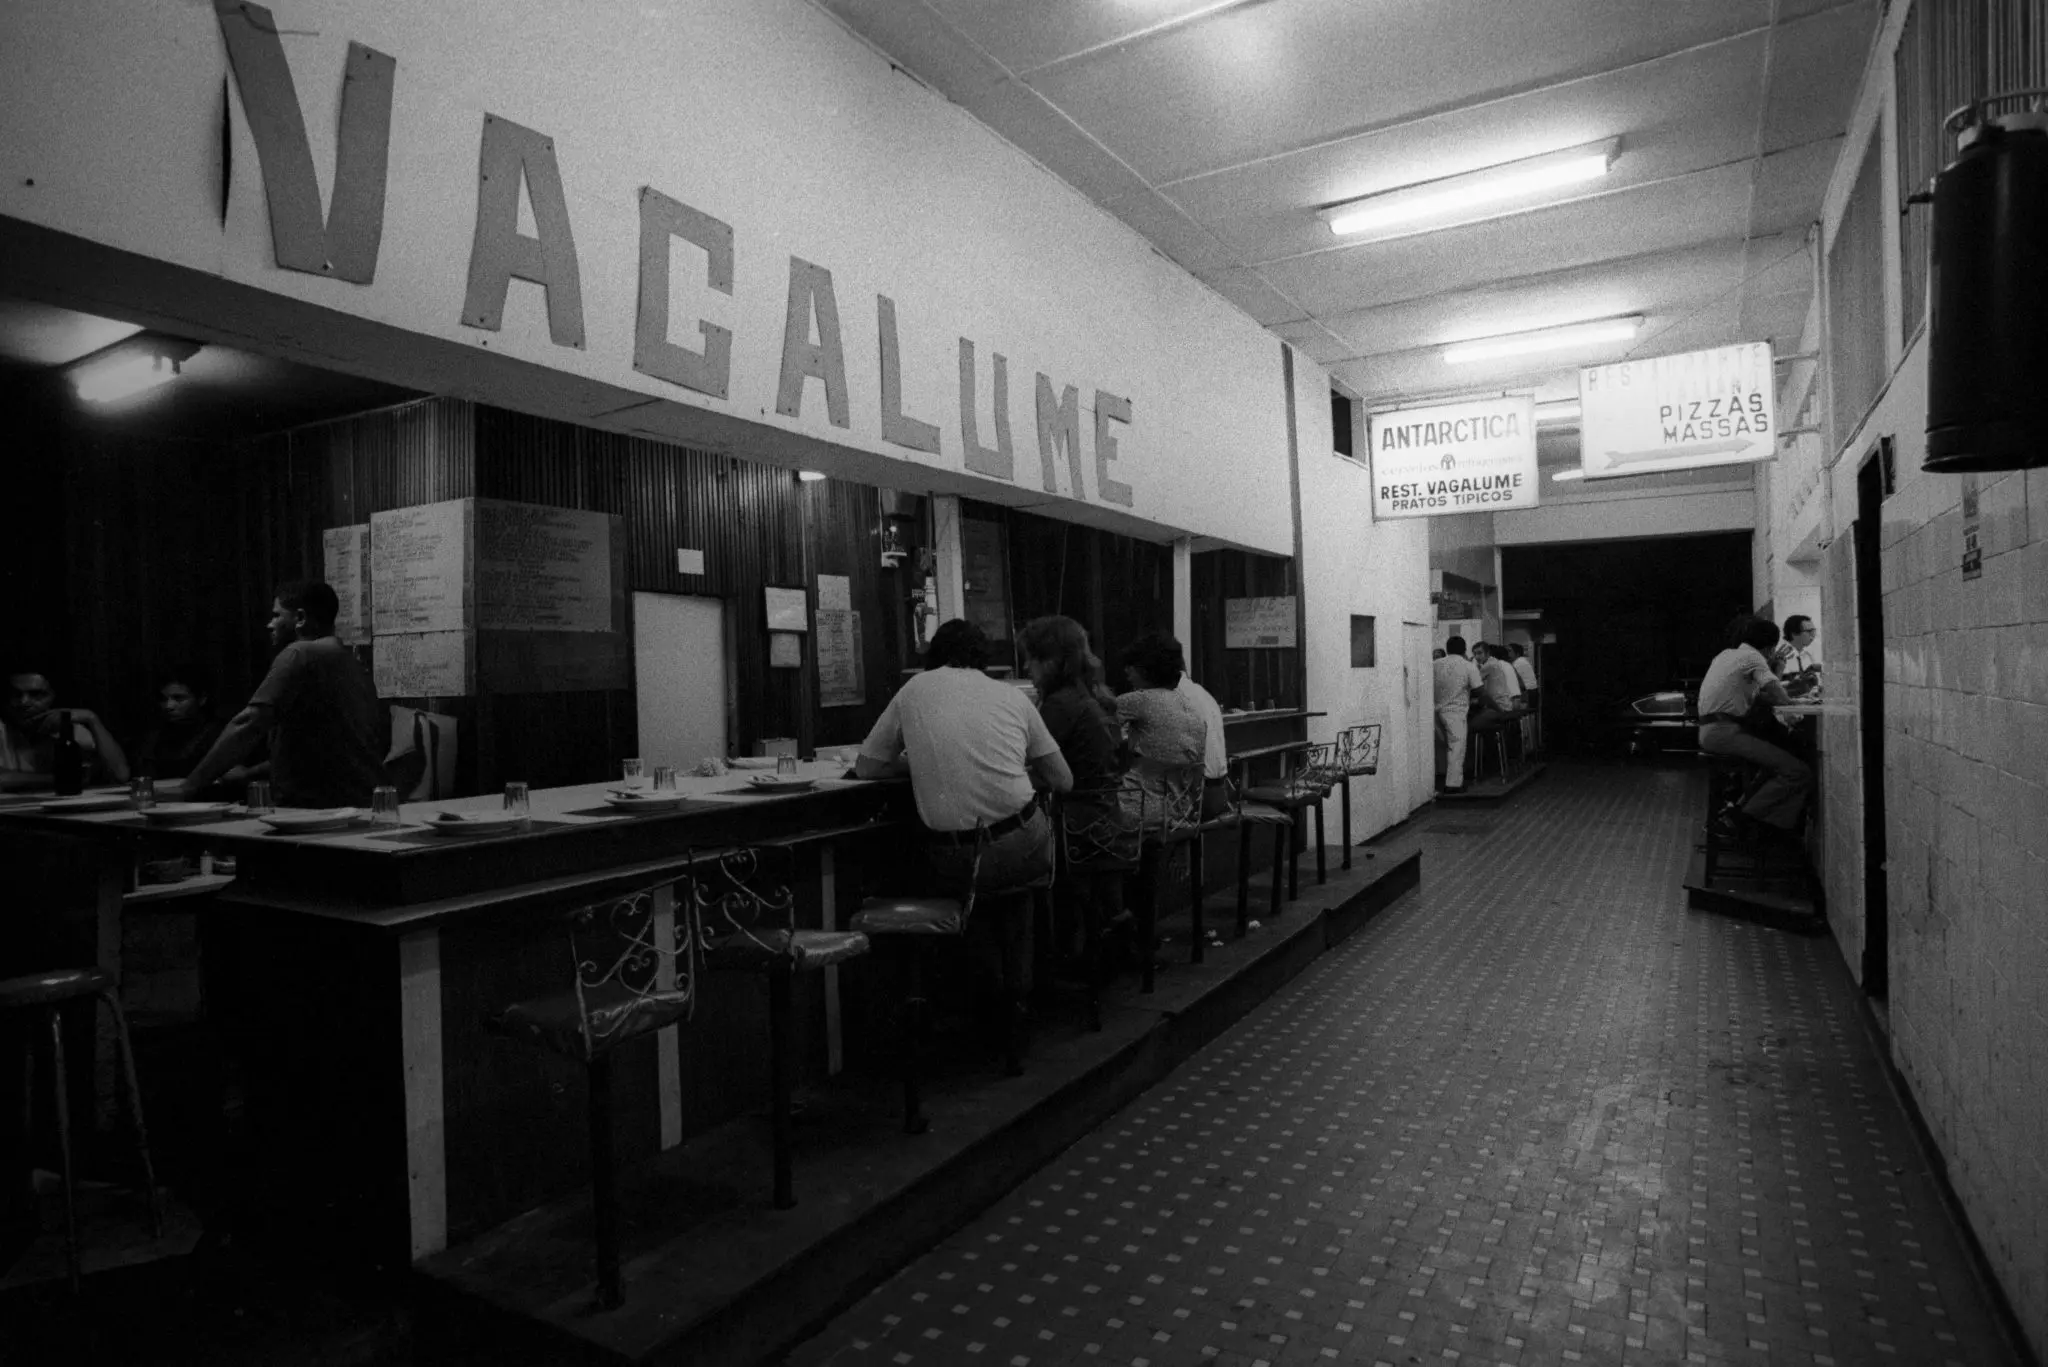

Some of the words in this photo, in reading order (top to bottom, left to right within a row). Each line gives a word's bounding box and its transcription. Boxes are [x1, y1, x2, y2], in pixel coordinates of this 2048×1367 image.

[212, 0, 1134, 507] VAGALUME
[1660, 393, 1763, 424] PIZZAS
[1382, 413, 1520, 450] ANTARCTICA
[1664, 413, 1769, 444] MASSAS
[1381, 483, 1422, 499] REST.
[1427, 473, 1523, 495] VAGALUME
[1392, 496, 1447, 510] PRATOS
